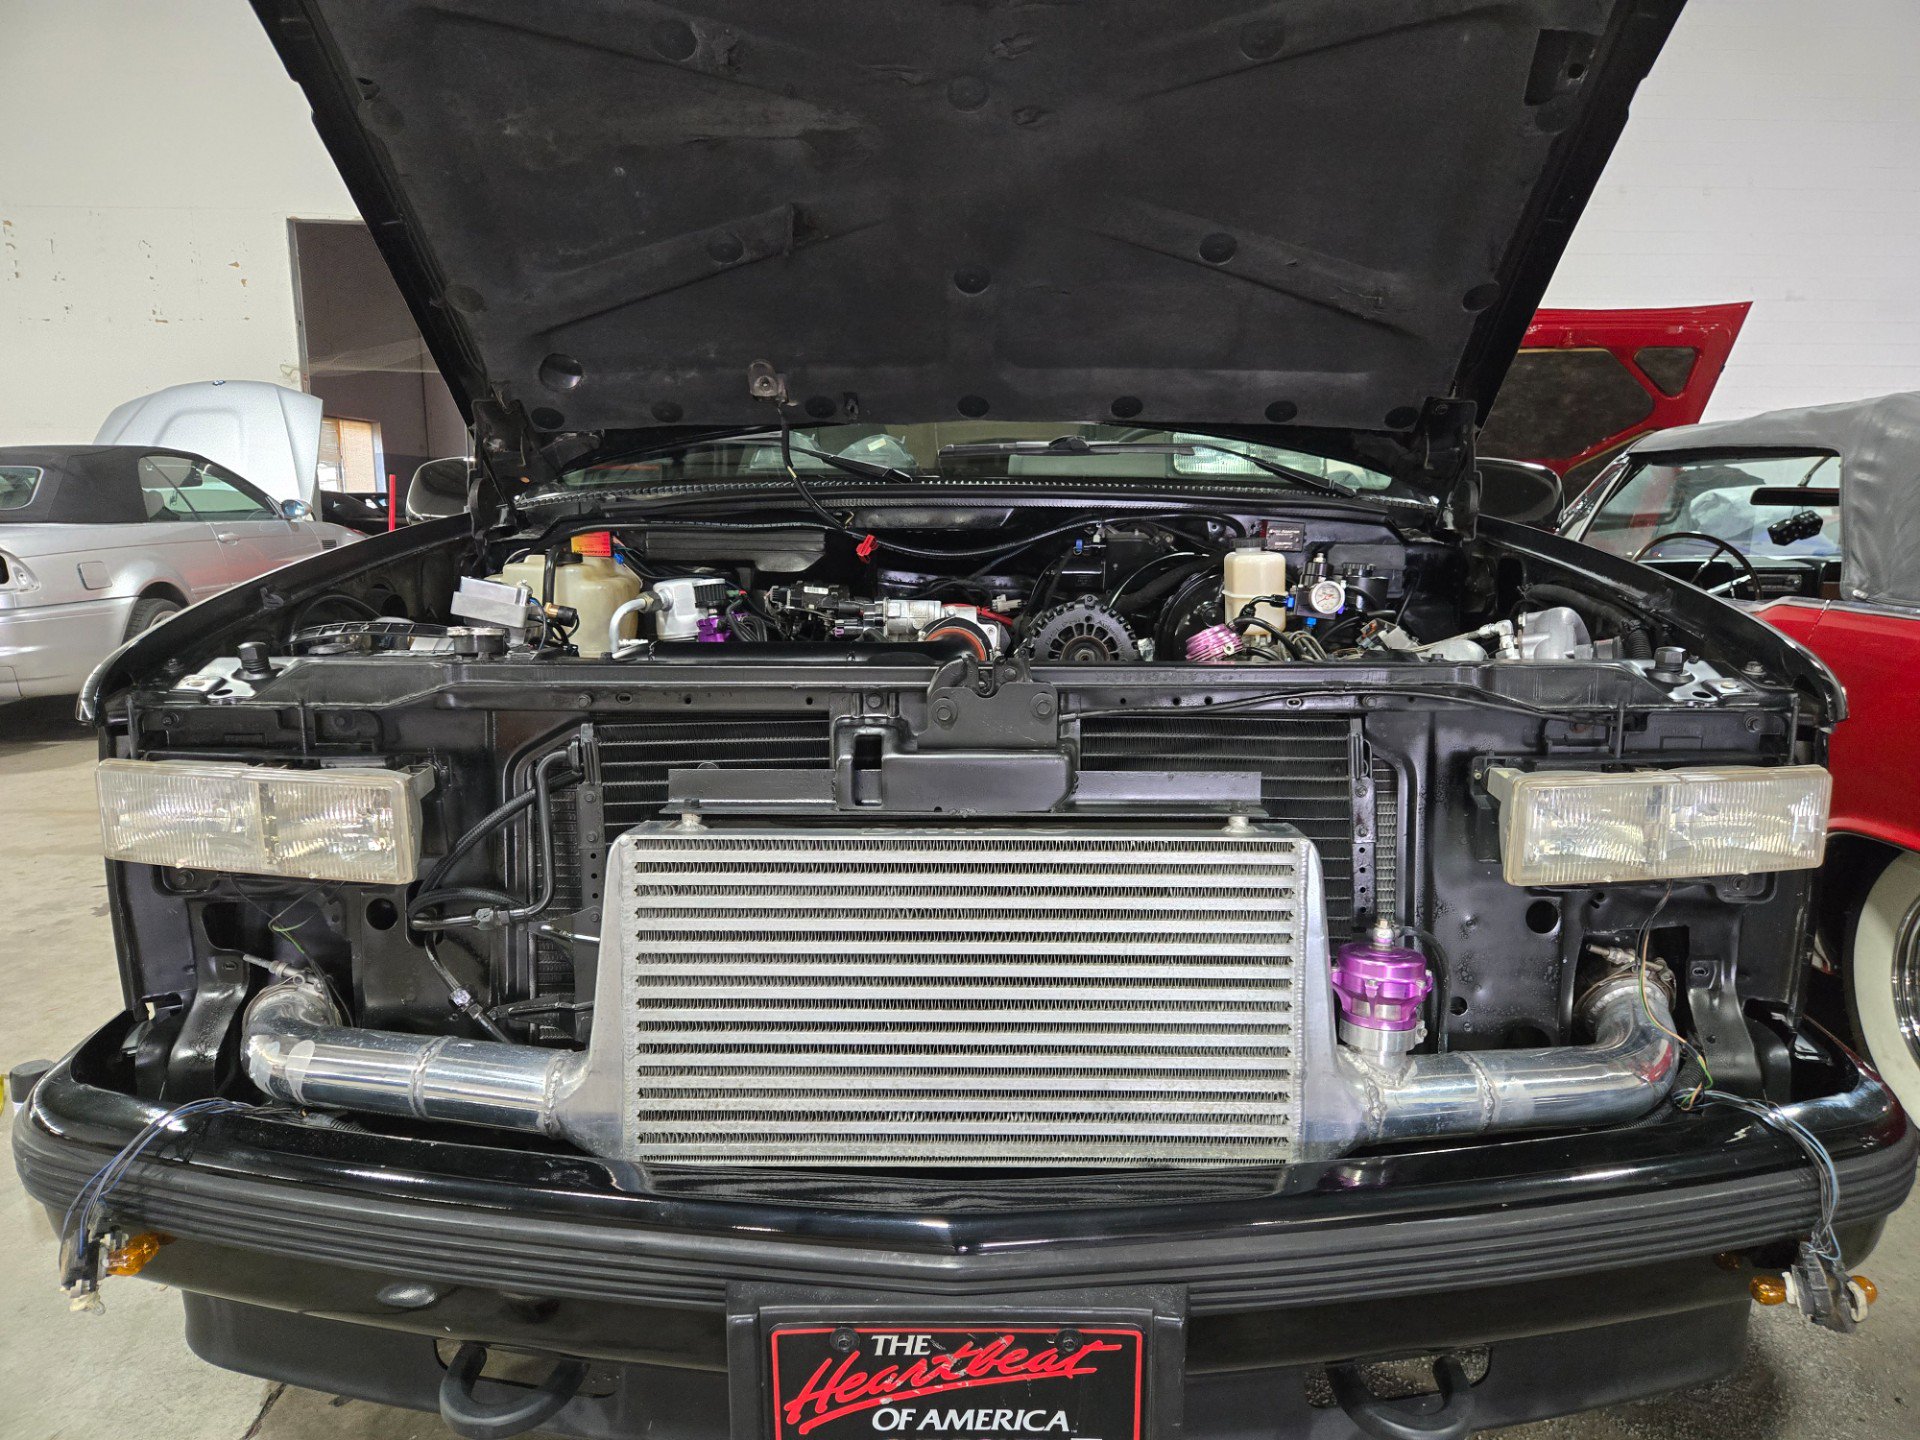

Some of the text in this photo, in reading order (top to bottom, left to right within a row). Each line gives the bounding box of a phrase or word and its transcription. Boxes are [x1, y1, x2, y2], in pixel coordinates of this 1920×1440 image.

[871, 1334, 932, 1357] THE
[783, 1335, 1122, 1426] Heartbeat
[871, 1407, 1070, 1433] OF AMERICA
